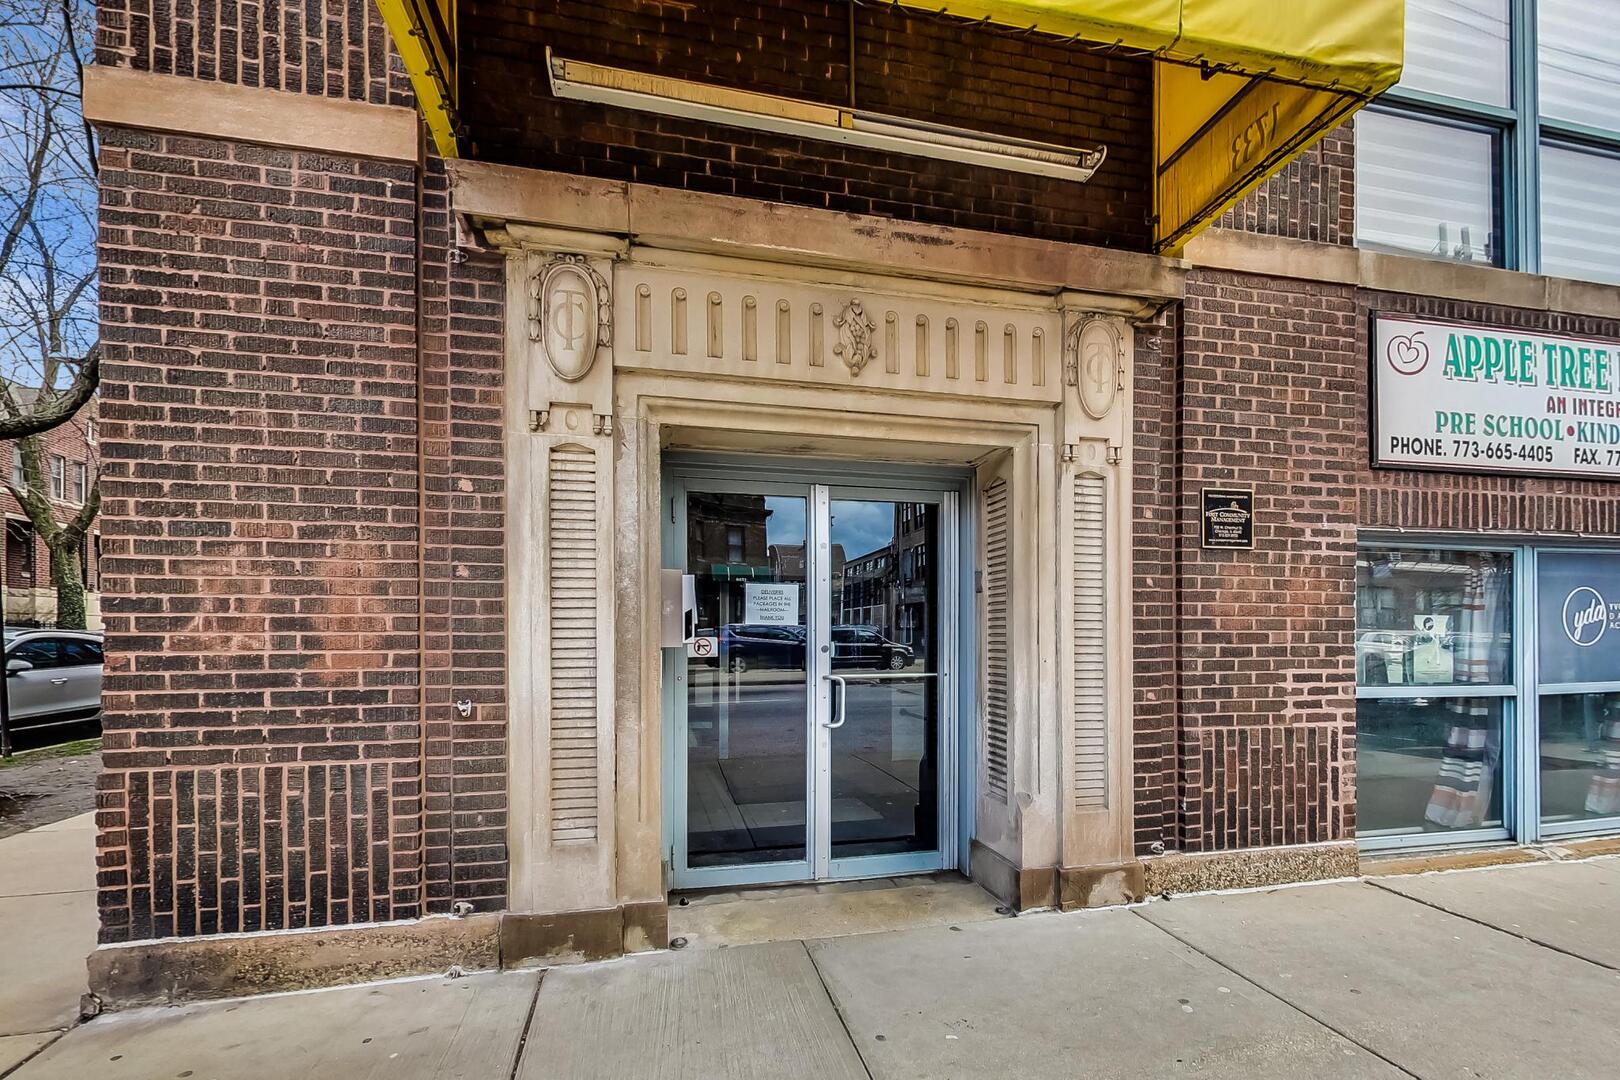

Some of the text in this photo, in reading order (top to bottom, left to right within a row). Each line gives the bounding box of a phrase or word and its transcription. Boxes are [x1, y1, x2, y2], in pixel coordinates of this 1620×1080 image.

[1443, 333, 1612, 394] APPLE TREE
[1547, 396, 1566, 414] AN
[1435, 411, 1620, 445] PRE SCHOOL KIND
[1391, 436, 1620, 467] PHONE. 773-665-4405 FAX. 77
[1574, 598, 1605, 640] yda
